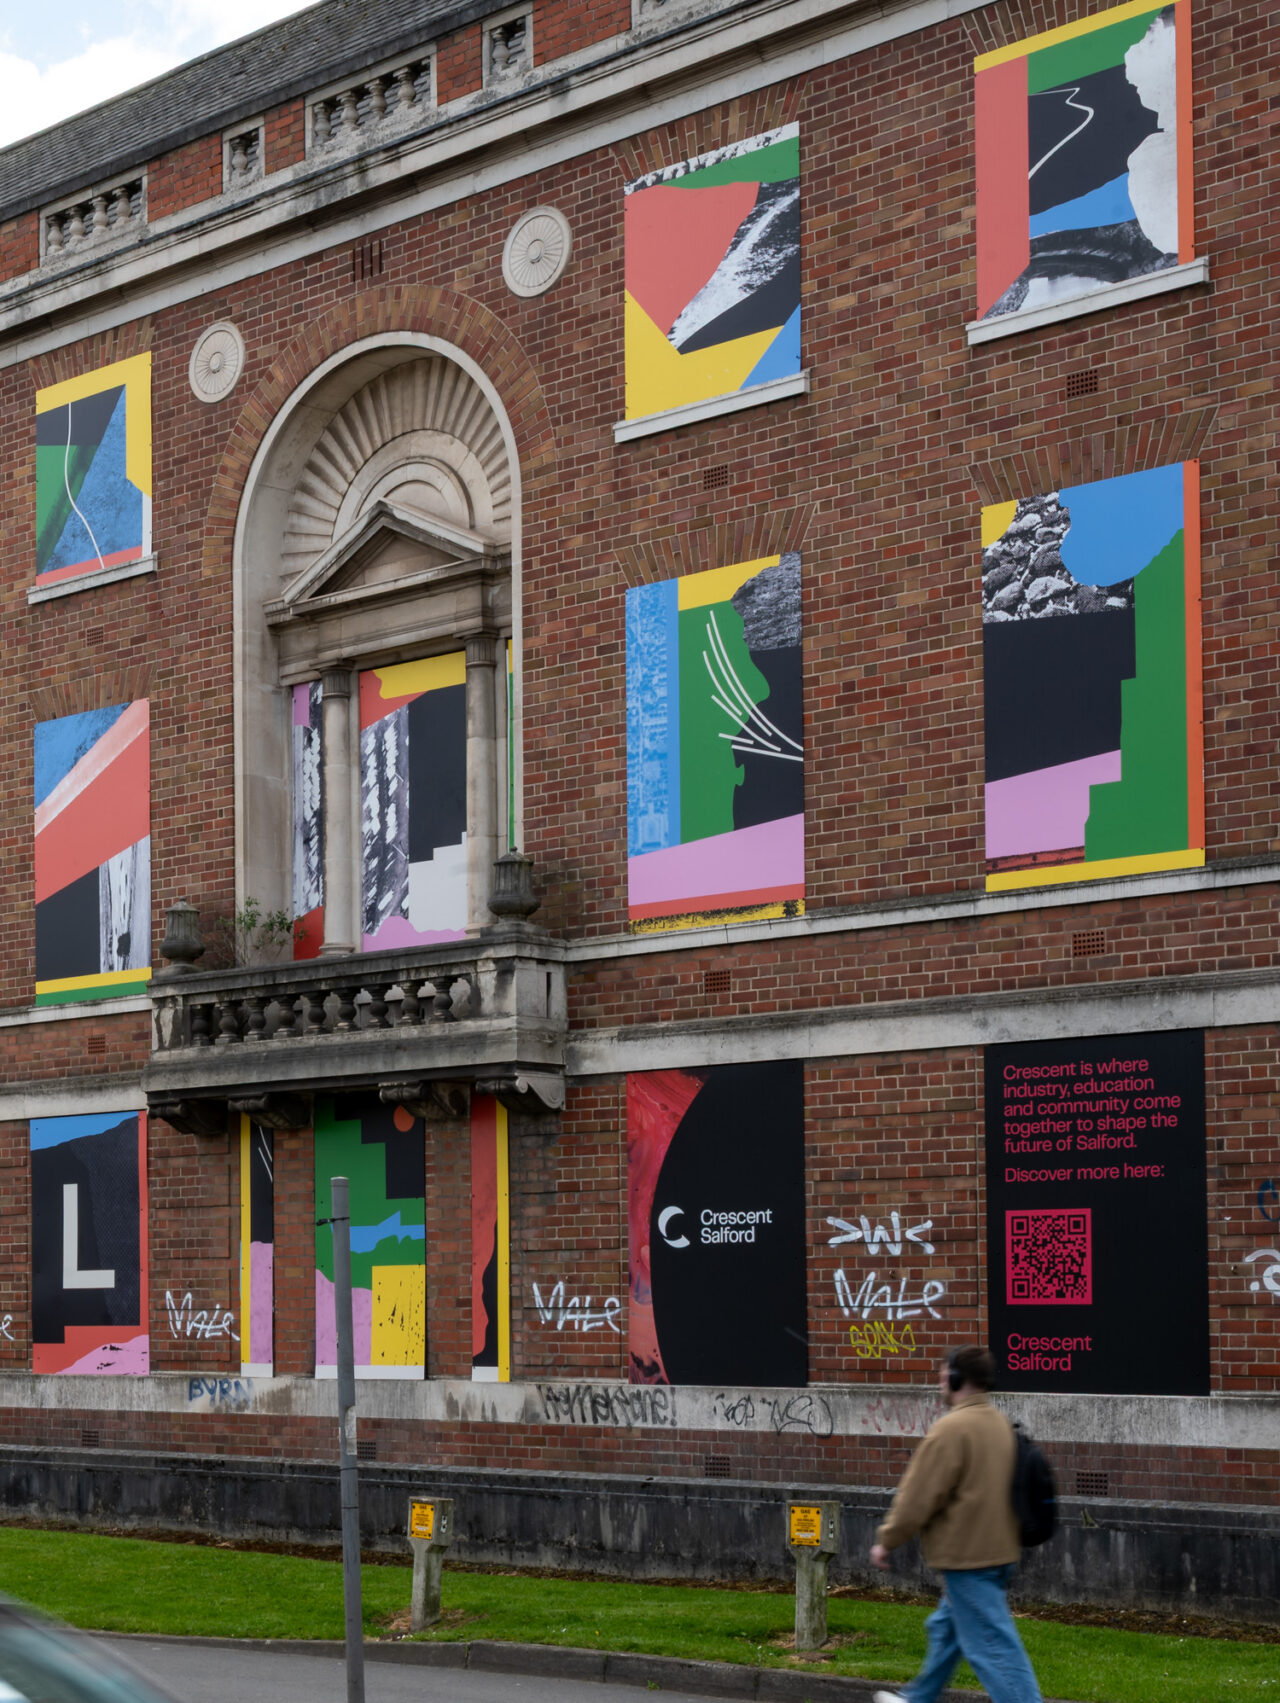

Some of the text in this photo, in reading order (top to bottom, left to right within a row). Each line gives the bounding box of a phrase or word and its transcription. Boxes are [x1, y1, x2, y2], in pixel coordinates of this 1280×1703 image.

[1003, 1058, 1149, 1081] Crescent is where
[1003, 1076, 1155, 1099] industry, education
[1004, 1094, 1181, 1117] and community come
[1004, 1112, 1178, 1138] together to shape the
[1004, 1133, 1138, 1153] future of Salford.
[1004, 1162, 1165, 1183] Discover more here:
[700, 1207, 772, 1226] Crescent
[700, 1226, 755, 1244] Salford
[1007, 1333, 1092, 1351] Crescent
[1007, 1353, 1071, 1372] Salford
